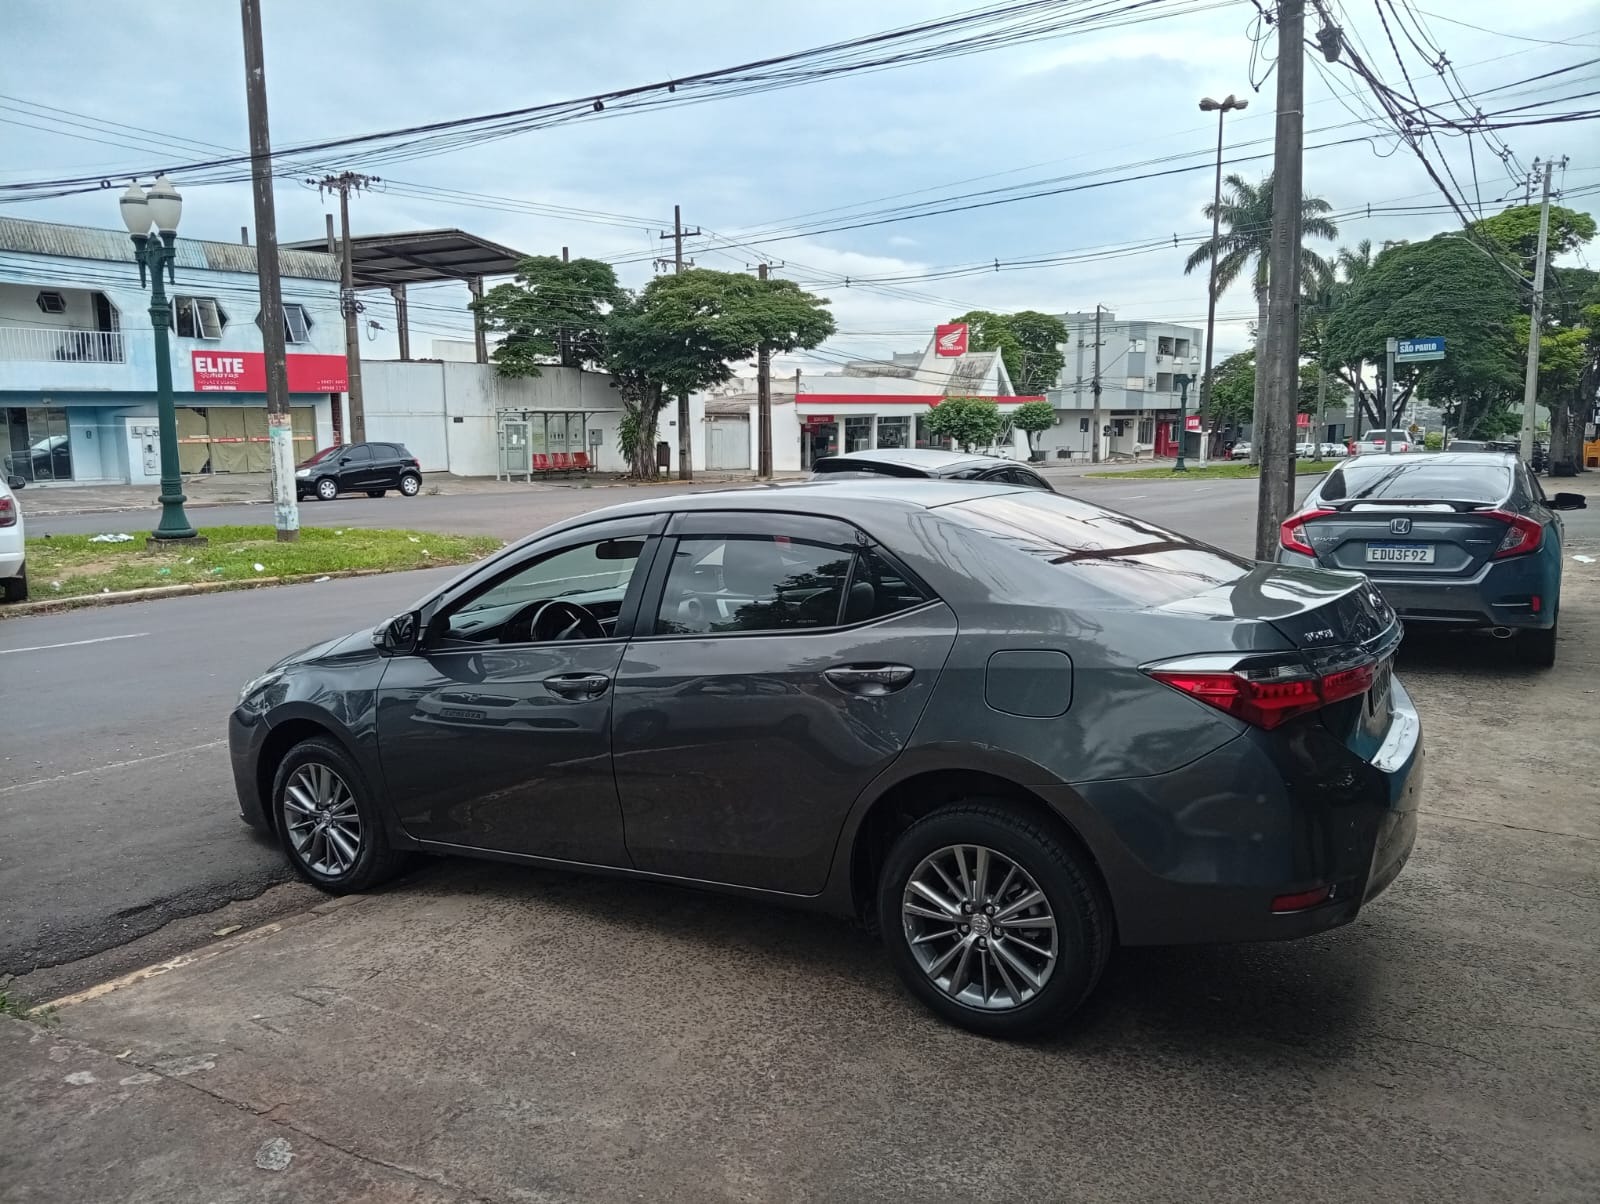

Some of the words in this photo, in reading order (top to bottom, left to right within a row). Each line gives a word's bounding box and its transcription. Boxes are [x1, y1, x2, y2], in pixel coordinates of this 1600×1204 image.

[1400, 343, 1414, 353] SÃO
[1415, 342, 1437, 352] PAULO
[195, 357, 244, 373] ELITE
[1372, 551, 1427, 561] EDU3F92
